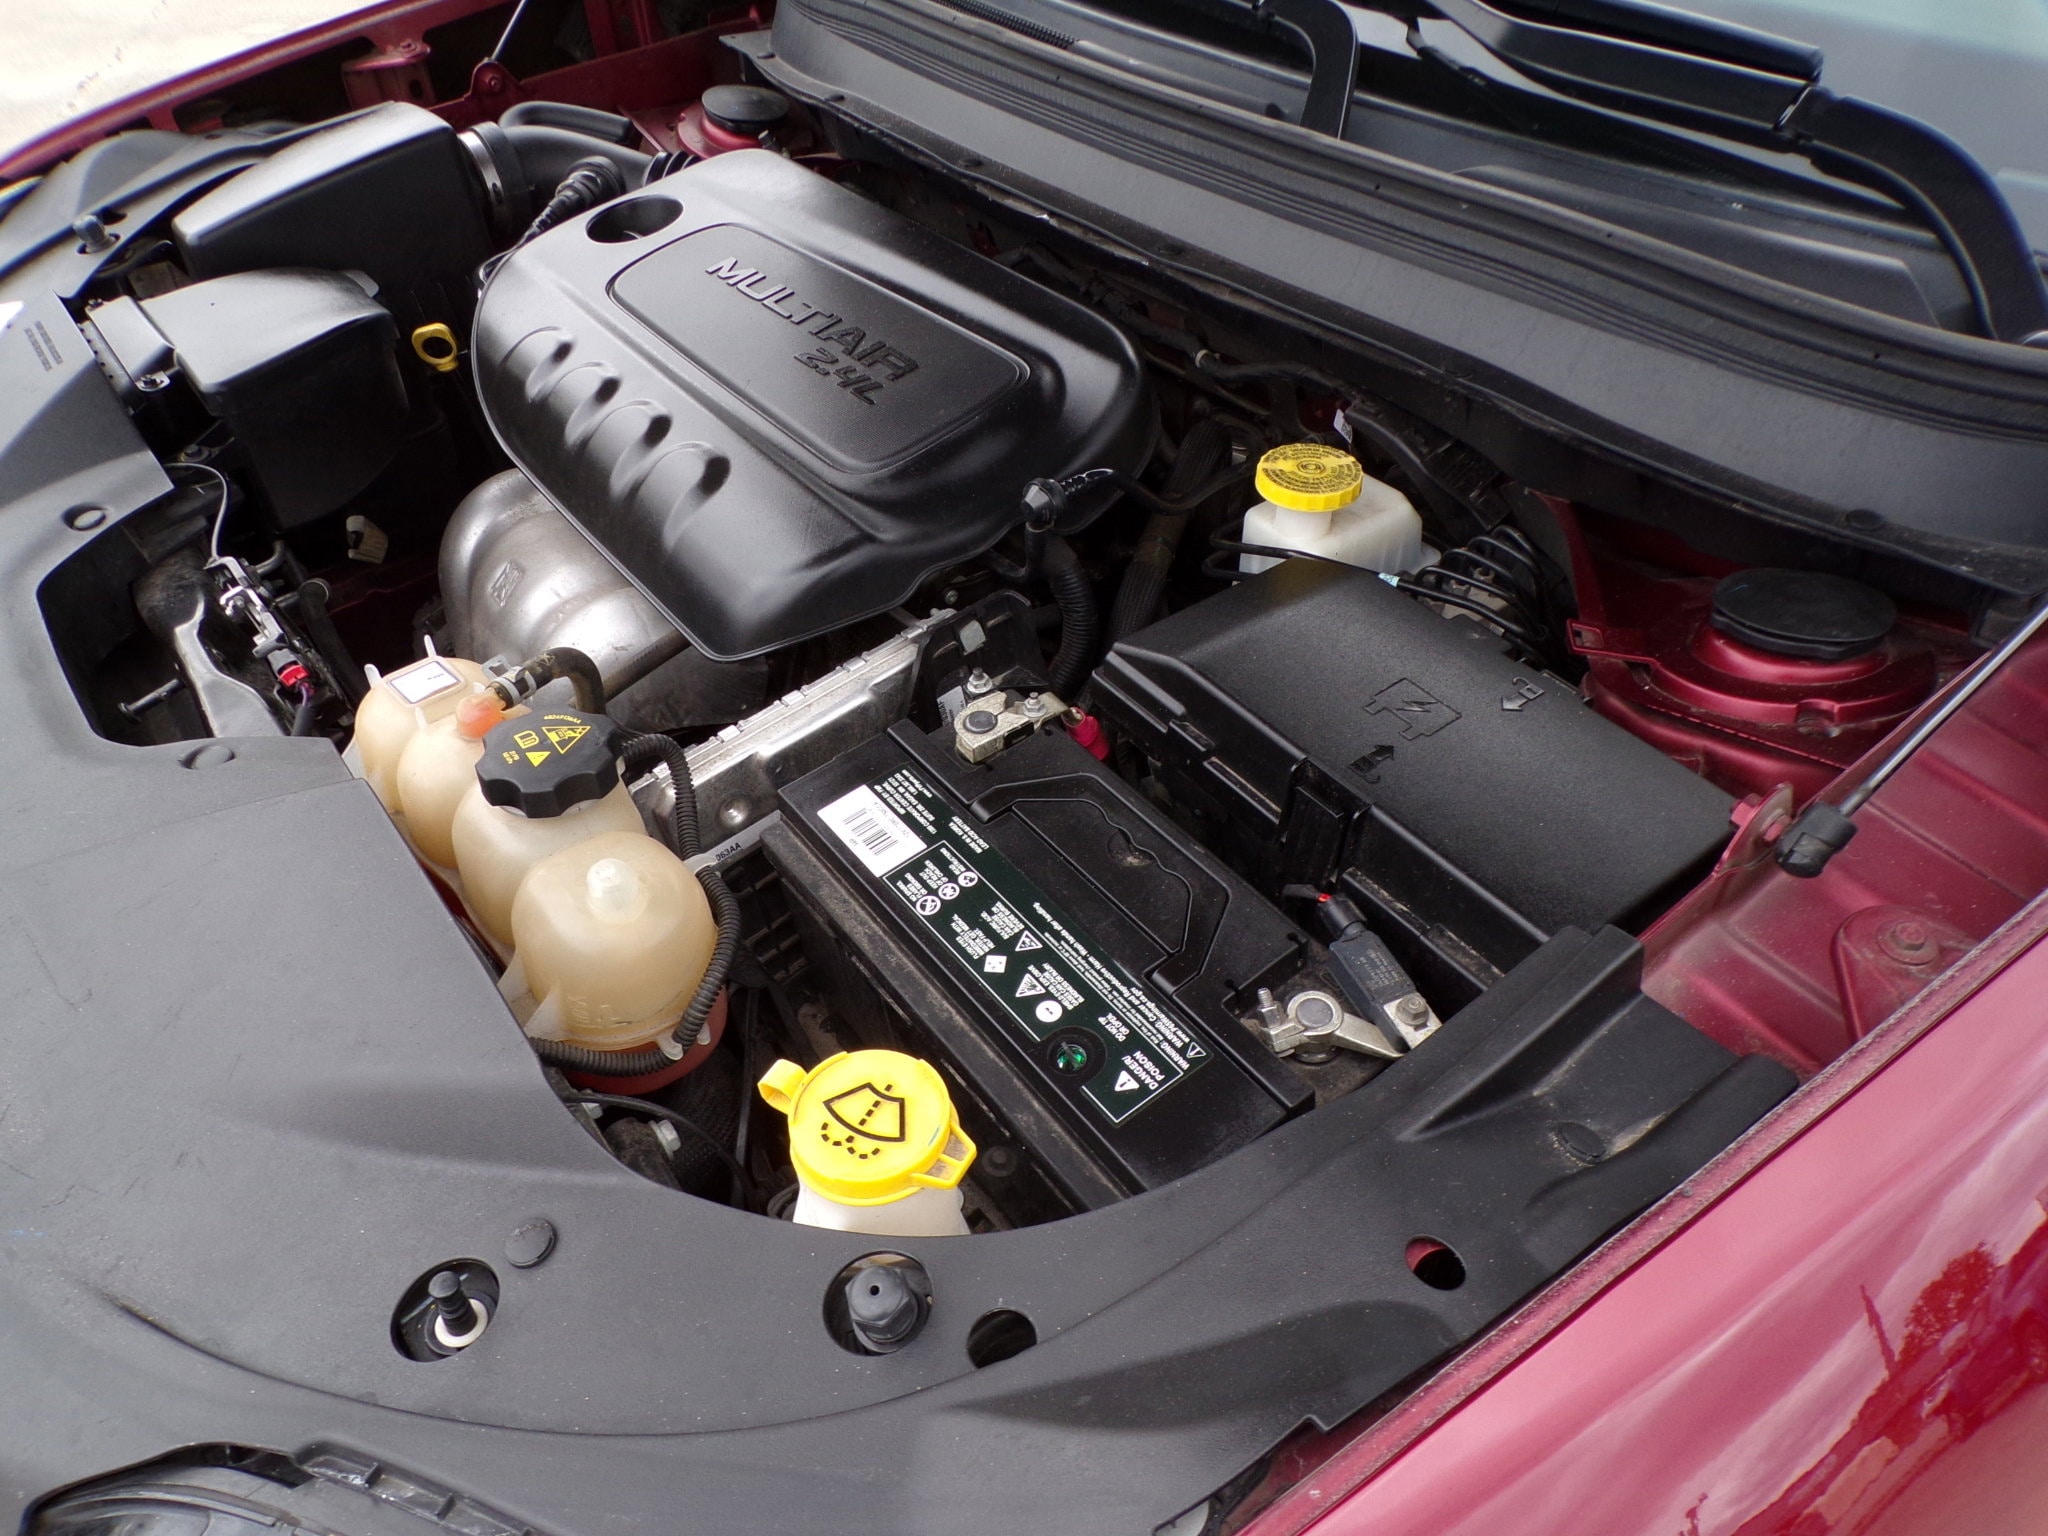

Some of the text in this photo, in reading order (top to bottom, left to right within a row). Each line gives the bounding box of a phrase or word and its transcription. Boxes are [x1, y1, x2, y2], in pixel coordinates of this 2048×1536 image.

[705, 256, 919, 382] MULTIAIR
[793, 347, 884, 405] 2.4L
[950, 814, 971, 832] BATTERY
[990, 905, 1000, 914] OR
[990, 913, 1015, 936] CAN CAUSE
[1047, 919, 1063, 932] after
[954, 935, 969, 947] EYES
[965, 928, 978, 939] GET
[1057, 928, 1076, 944] hands
[981, 936, 996, 949] HELP
[1070, 941, 1089, 956] Wash
[1085, 955, 1103, 970] Harm
[1041, 970, 1059, 986] CAUSE
[1053, 973, 1065, 983] OR
[1097, 965, 1133, 998] Reproductive
[1054, 983, 1067, 994] CAN
[1059, 980, 1085, 1003] BLINDNESS
[1126, 994, 1141, 1006] and
[1128, 984, 1192, 1044] www.P65Warnings.ca.gov
[1135, 1002, 1158, 1022] Cancer
[1096, 1014, 1126, 1042] DO NOT TIP
[1118, 1024, 1130, 1035] OR
[1152, 1018, 1185, 1048] WARNING:
[1157, 1039, 1191, 1070] WARNING:
[1120, 1053, 1160, 1090] DANGER/
[1132, 1049, 1166, 1081] POISON
